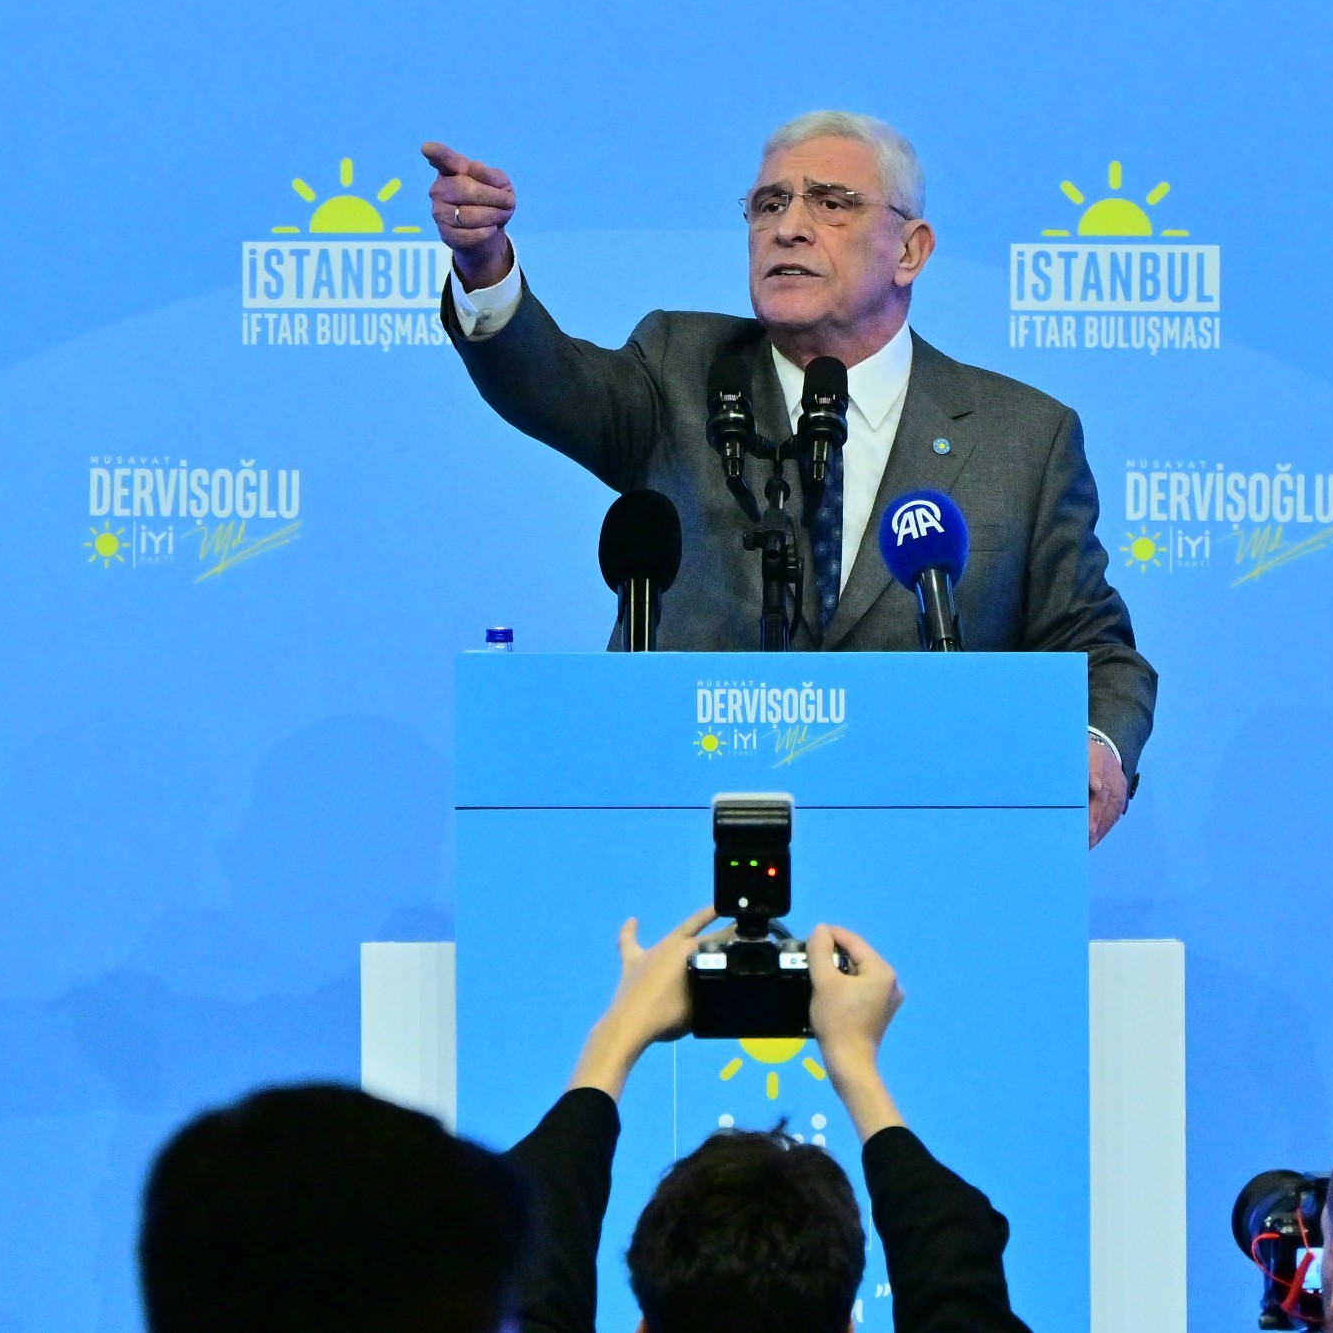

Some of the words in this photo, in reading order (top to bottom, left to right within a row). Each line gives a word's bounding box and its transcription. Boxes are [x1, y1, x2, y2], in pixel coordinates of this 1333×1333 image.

[1017, 250, 1214, 303] İSTANBUL
[242, 313, 309, 346] İFTAR
[317, 313, 453, 352] BULUŞMAS
[1010, 315, 1077, 348] İFTAR
[1084, 316, 1220, 356] BULUŞMASI
[90, 455, 170, 465] MÜSAVAT
[89, 458, 300, 525] DERVİŞOĞLU
[140, 525, 174, 554] İYİ
[1177, 530, 1211, 559] İYİ
[696, 682, 846, 729] DERVİŞOĞLU
[733, 729, 757, 750] İYİ
